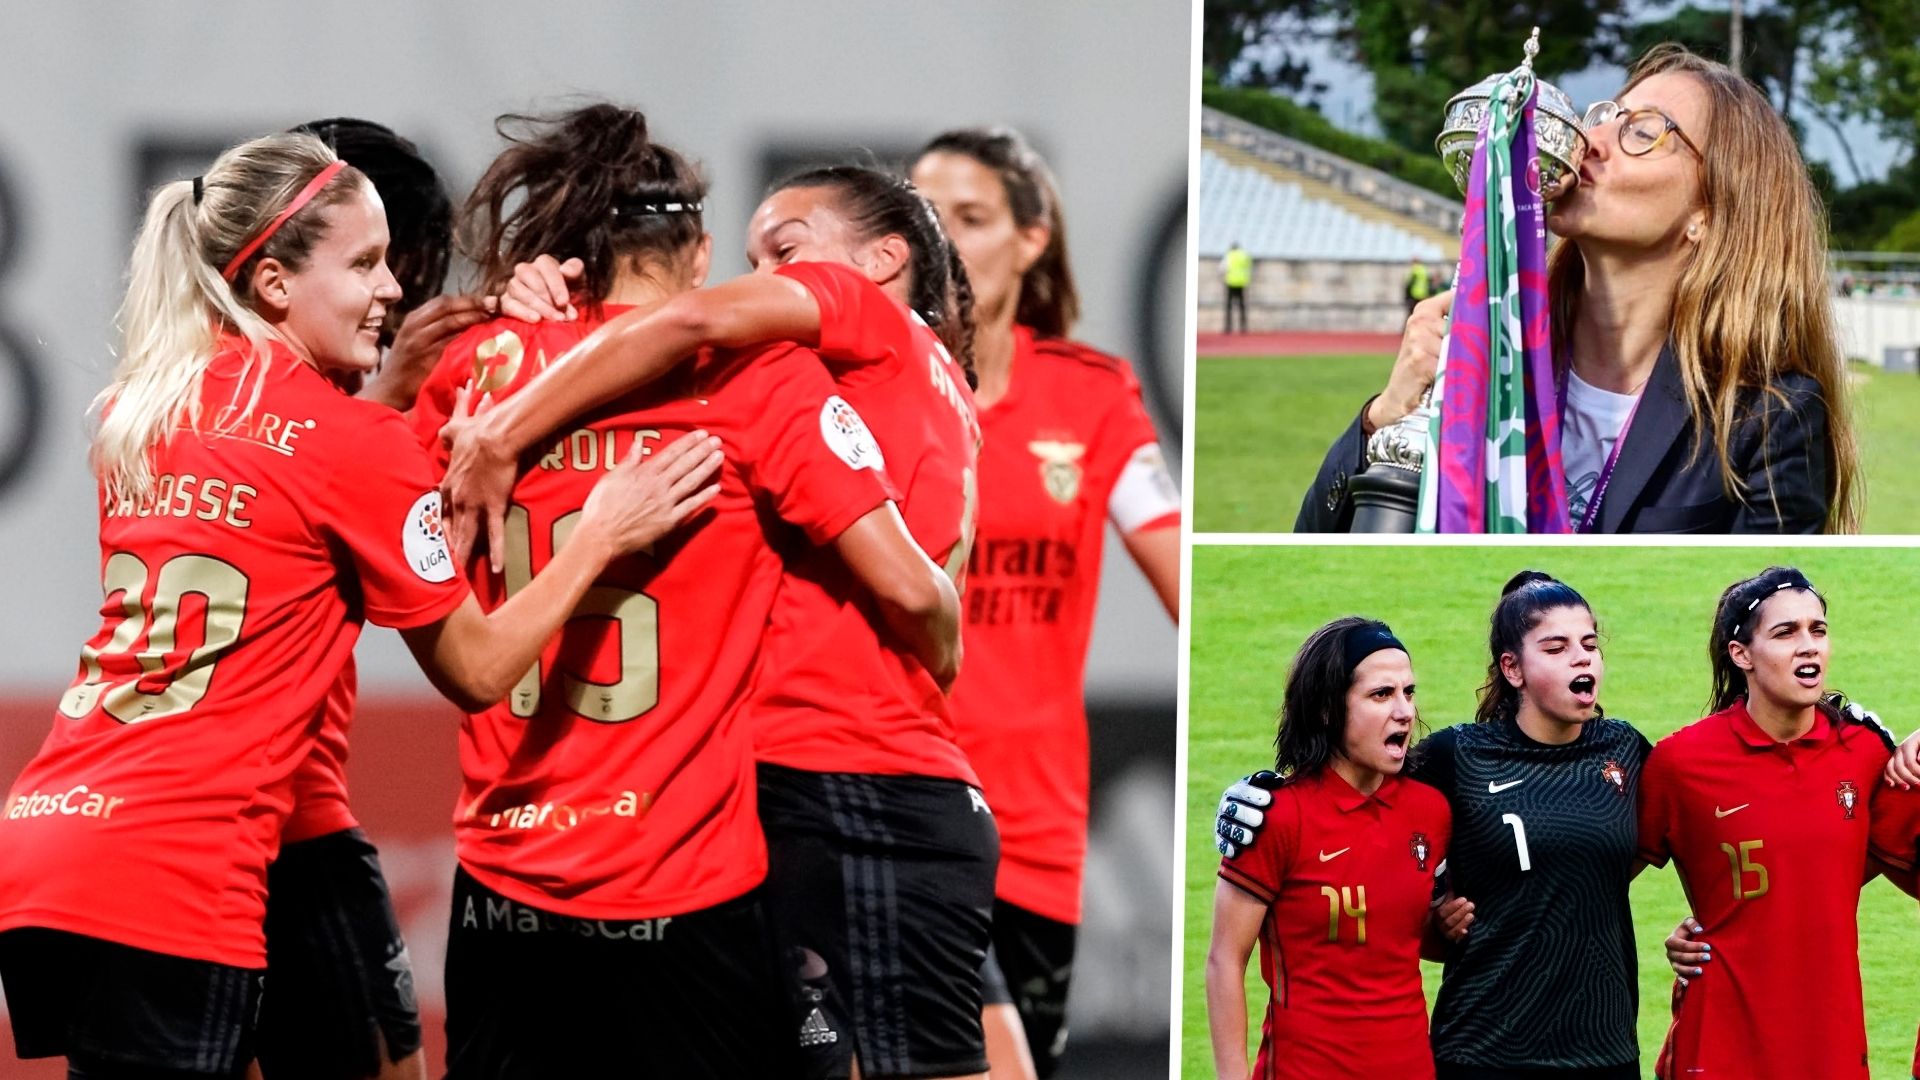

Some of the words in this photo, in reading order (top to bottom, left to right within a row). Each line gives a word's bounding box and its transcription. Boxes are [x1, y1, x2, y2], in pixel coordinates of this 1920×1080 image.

[419, 548, 448, 572] LIGA
[60, 551, 250, 725] 20
[1502, 813, 1531, 872] 1
[1720, 839, 1769, 900] 15
[1320, 885, 1366, 945] 14
